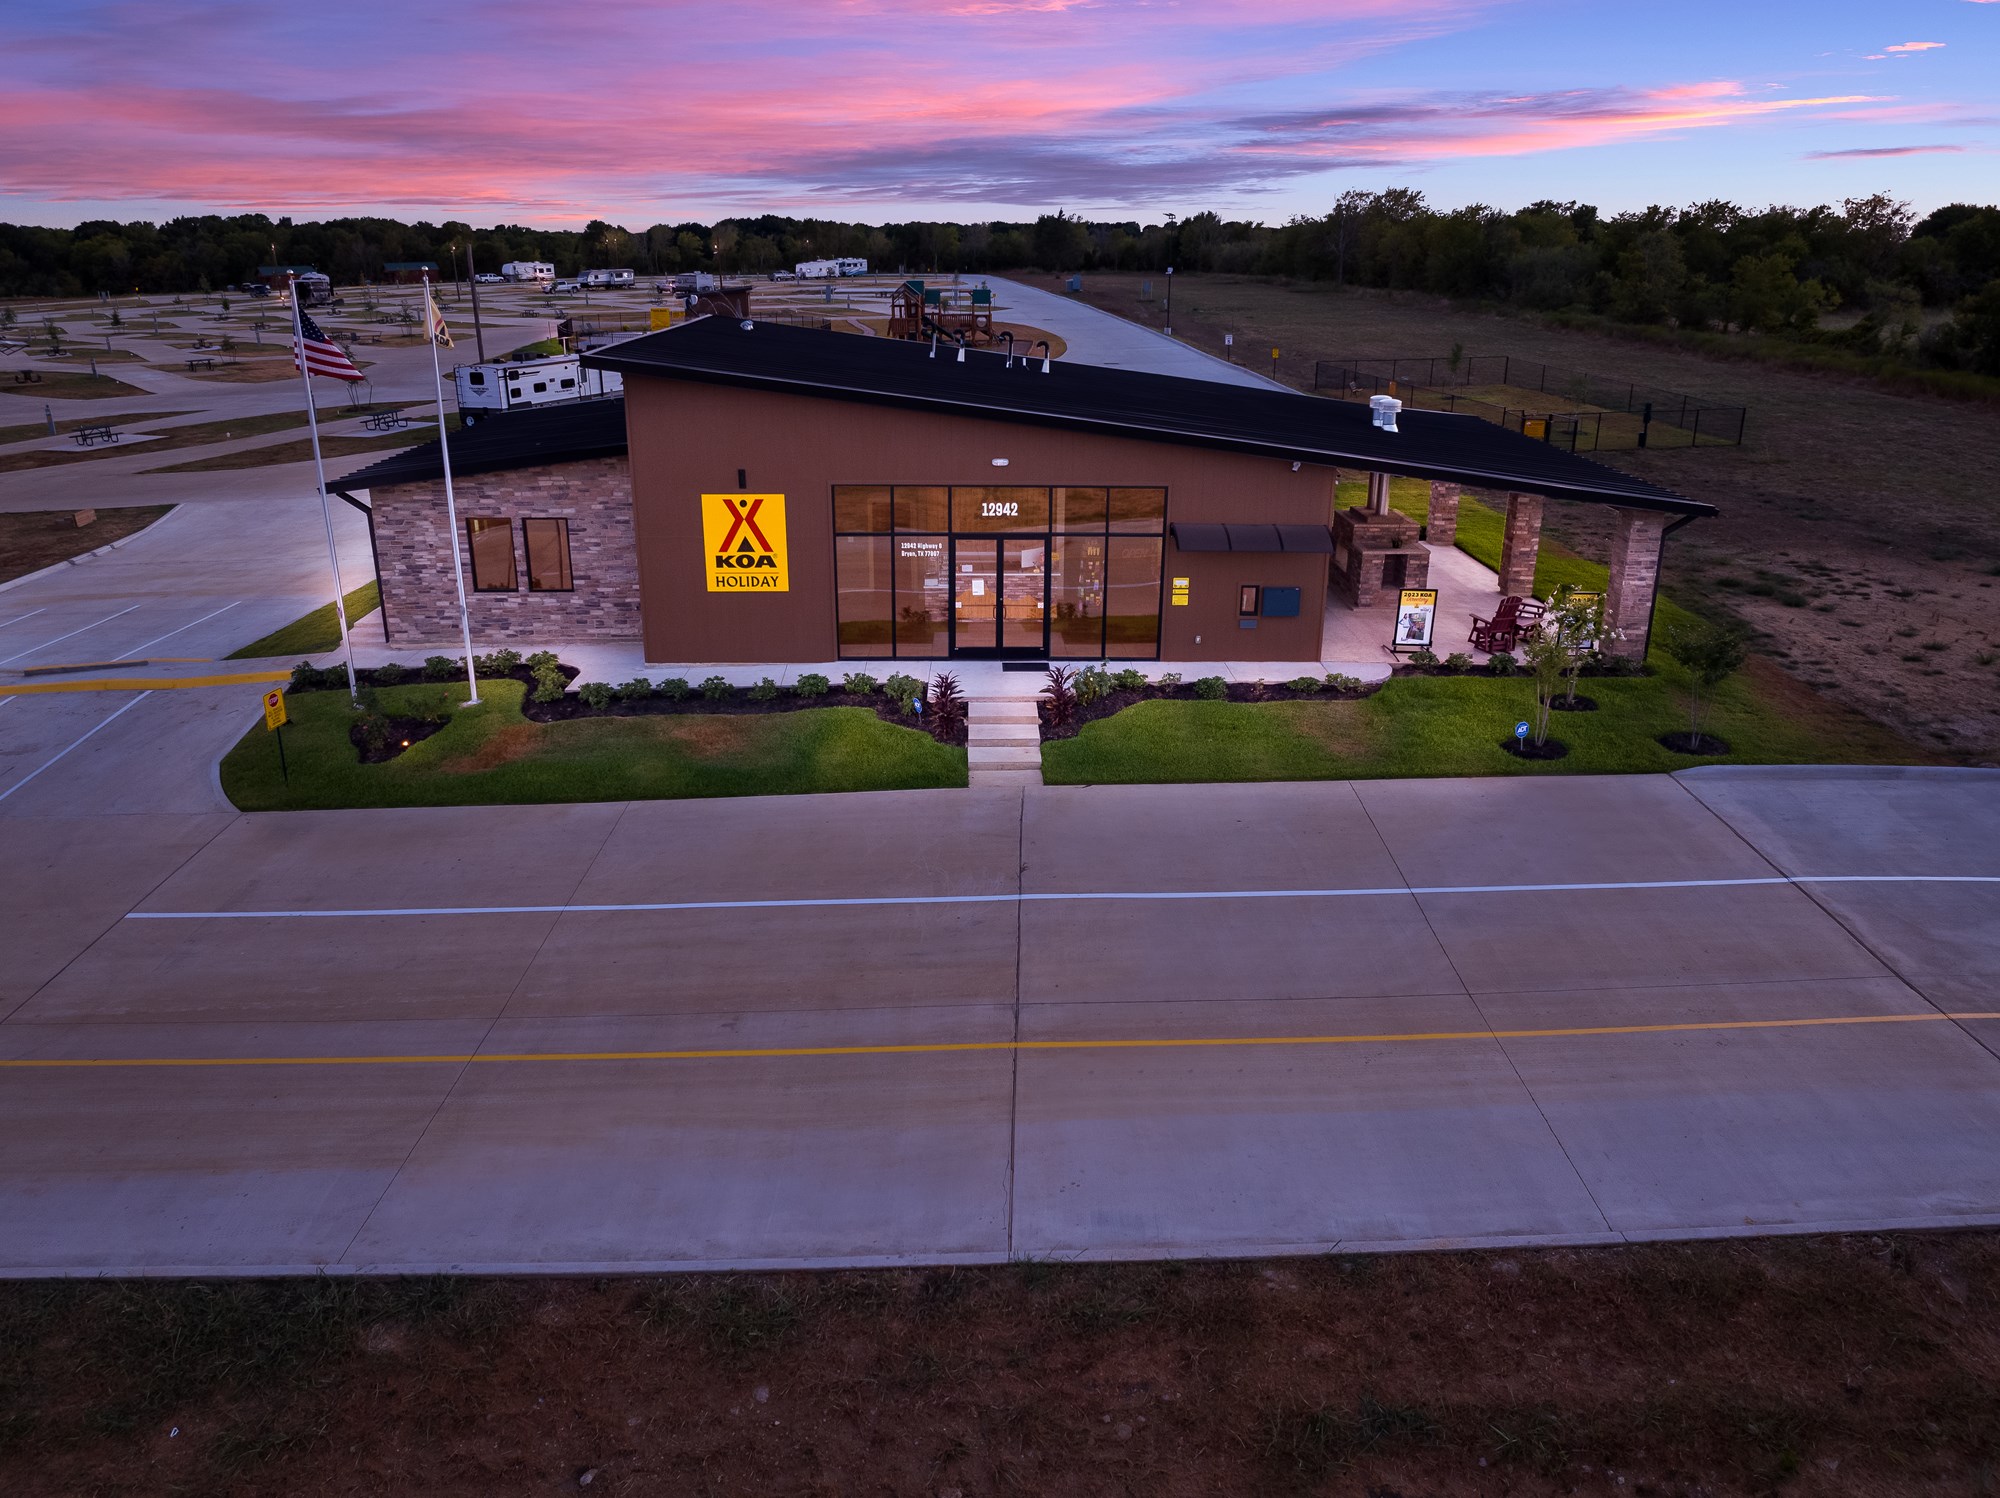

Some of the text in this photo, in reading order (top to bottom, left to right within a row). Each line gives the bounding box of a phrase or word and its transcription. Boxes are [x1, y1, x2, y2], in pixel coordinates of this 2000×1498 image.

[981, 502, 1018, 516] 12942
[917, 542, 938, 550] Highway
[715, 554, 777, 569] KOA
[715, 576, 779, 587] HOLIDAY
